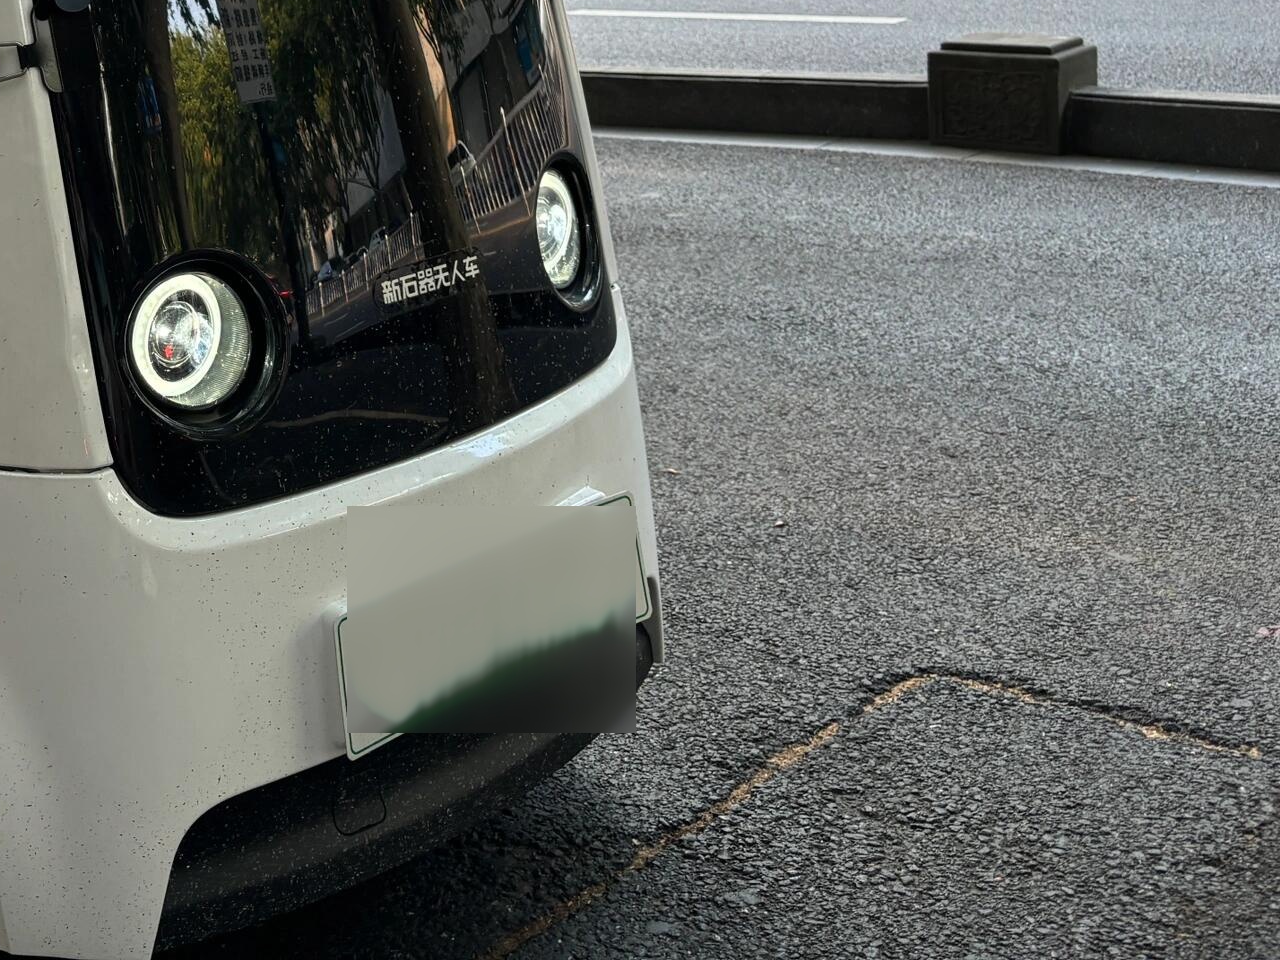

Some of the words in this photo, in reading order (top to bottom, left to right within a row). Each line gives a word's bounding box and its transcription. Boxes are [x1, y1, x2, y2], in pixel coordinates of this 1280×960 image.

[381, 255, 480, 305] 新石器无人车
